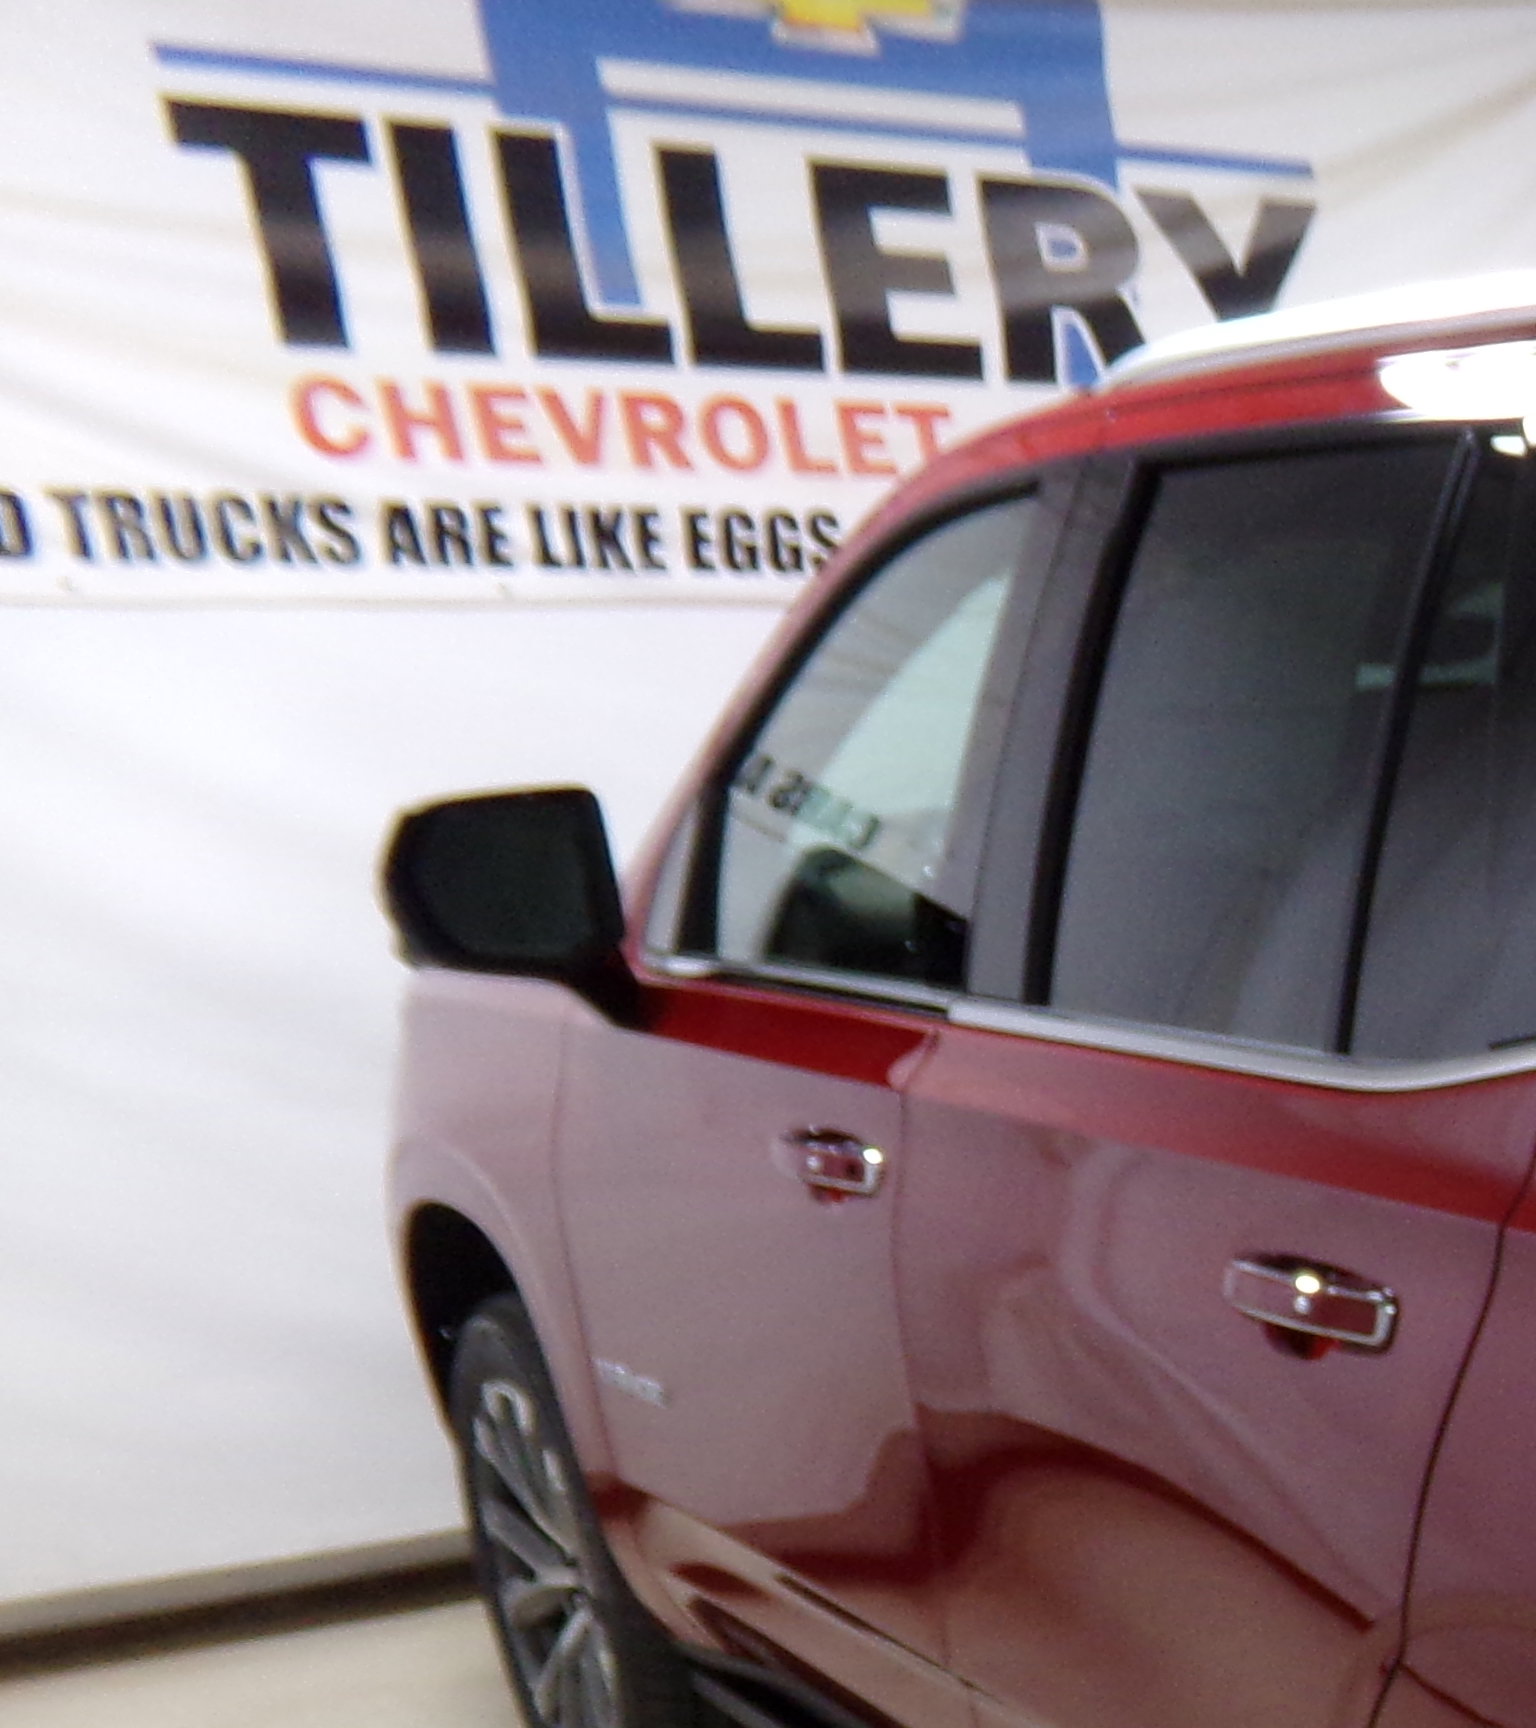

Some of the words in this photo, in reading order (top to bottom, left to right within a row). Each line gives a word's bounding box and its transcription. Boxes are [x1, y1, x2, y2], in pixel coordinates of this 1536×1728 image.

[161, 94, 1317, 385] TILLERY
[293, 374, 953, 477] CHEVROLET
[43, 487, 361, 567] TRUCKS
[379, 497, 512, 570] ARE
[525, 499, 666, 574] LIKE
[680, 504, 842, 574] EGGS
